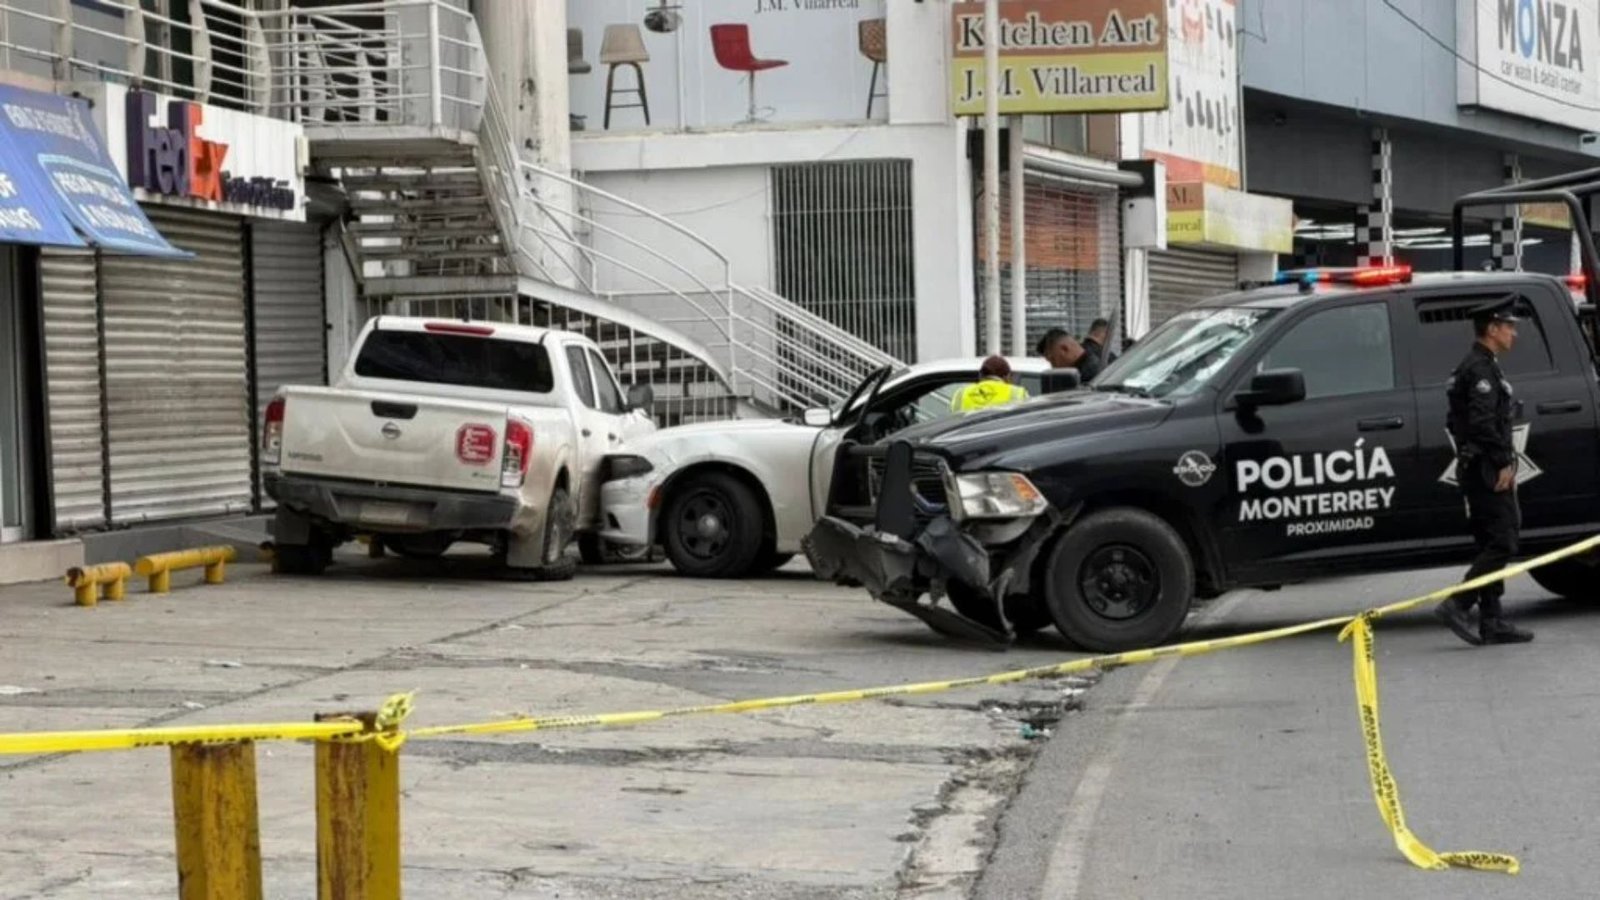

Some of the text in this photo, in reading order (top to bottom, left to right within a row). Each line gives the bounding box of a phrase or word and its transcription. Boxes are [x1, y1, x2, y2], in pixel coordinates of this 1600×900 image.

[961, 12, 1158, 48] Ktchen Art
[1497, 0, 1584, 73] MONZA
[1031, 64, 1156, 95] Villarreal
[125, 88, 229, 202] FedEx
[1236, 437, 1395, 492] POLICÍA
[1239, 486, 1395, 521] MONTERREY
[1286, 516, 1374, 536] PROXIMIDAD
